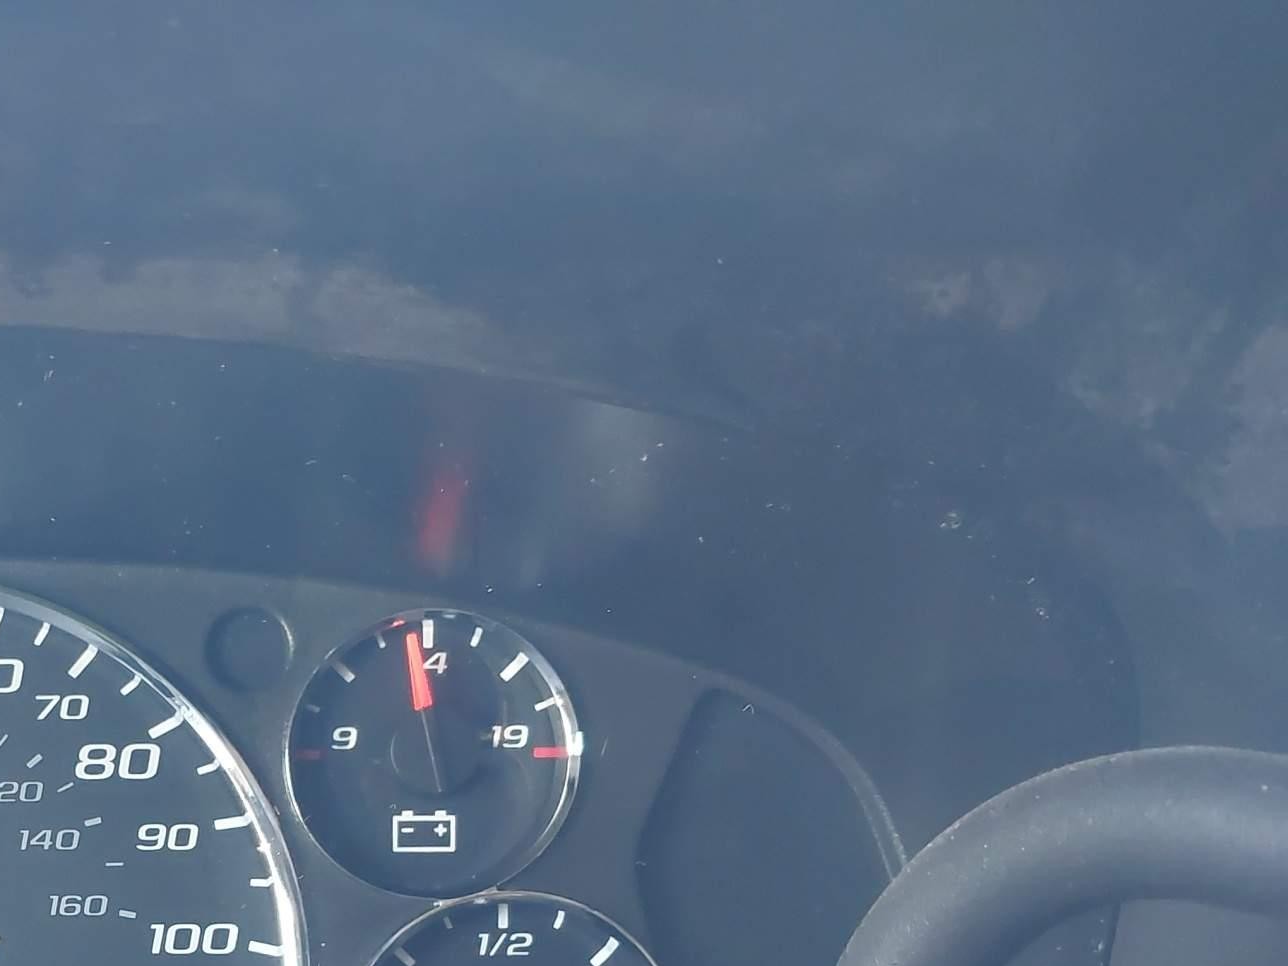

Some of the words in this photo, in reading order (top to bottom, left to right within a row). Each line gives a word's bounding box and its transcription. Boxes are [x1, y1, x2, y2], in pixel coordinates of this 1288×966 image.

[35, 695, 90, 720] 70
[331, 726, 358, 750] 9
[491, 724, 529, 749] 19
[74, 743, 161, 780] 80
[19, 829, 79, 850] 140
[135, 823, 199, 851] 90
[49, 895, 108, 916] 160
[149, 923, 239, 955] 100
[477, 933, 533, 957] 1/2
